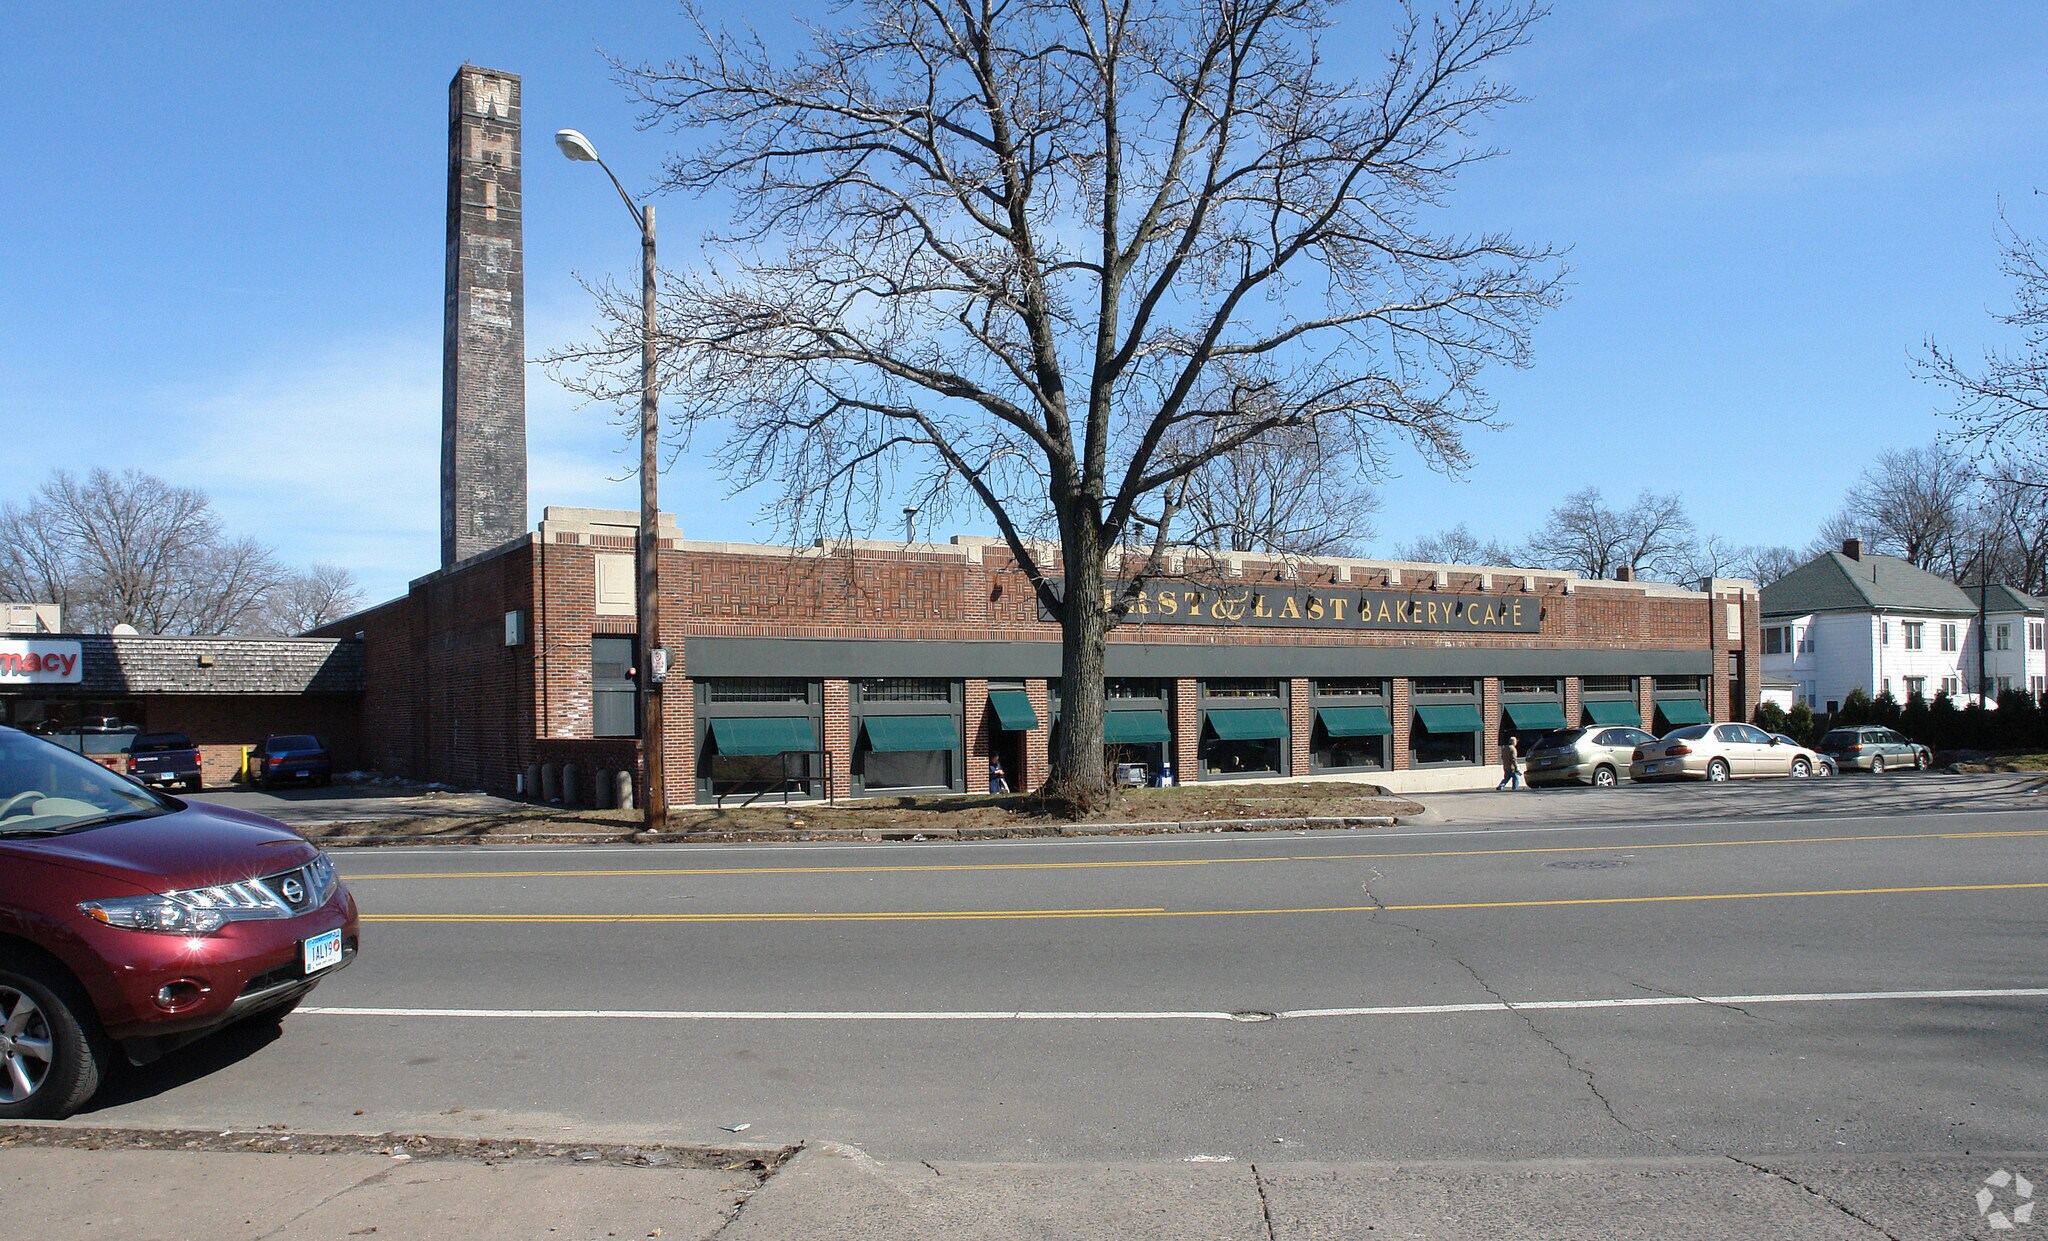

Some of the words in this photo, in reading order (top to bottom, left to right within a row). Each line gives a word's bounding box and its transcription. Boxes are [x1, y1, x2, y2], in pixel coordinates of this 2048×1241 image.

[1103, 588, 1205, 617] IRST
[1211, 590, 1249, 621] &
[1253, 594, 1347, 621] LAST
[1361, 598, 1453, 625] BAKERY
[1467, 599, 1522, 626] CAFÉ
